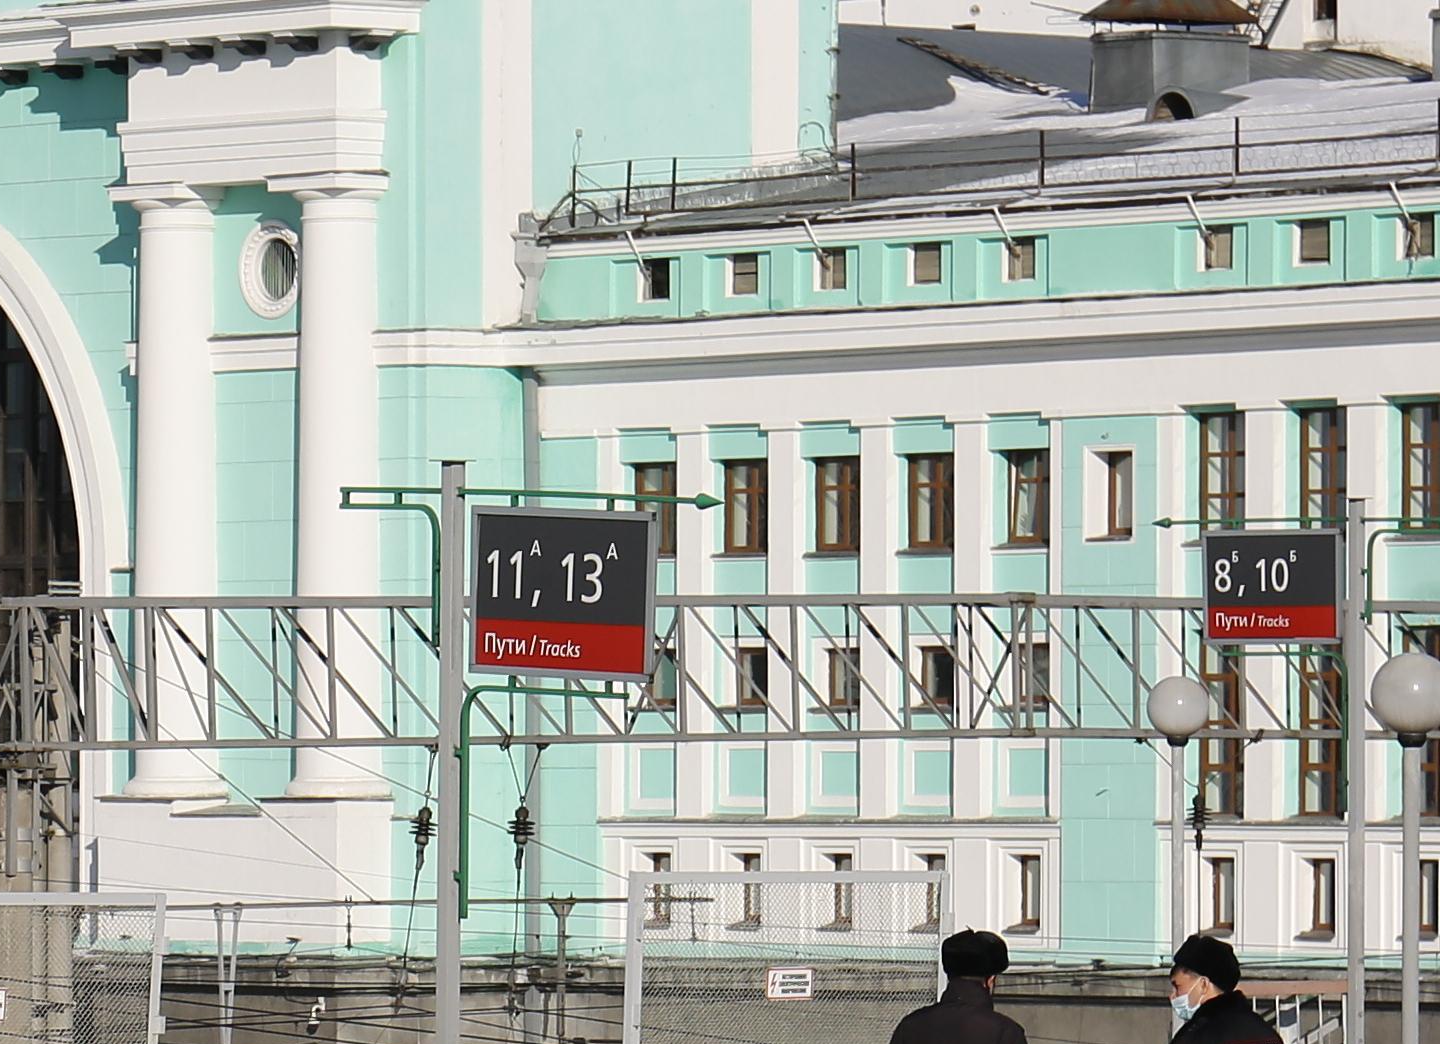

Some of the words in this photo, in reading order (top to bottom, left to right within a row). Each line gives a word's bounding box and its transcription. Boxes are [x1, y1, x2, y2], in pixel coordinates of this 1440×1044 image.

[1215, 612, 1248, 631] Пути
[1257, 614, 1290, 628] Tracks
[484, 632, 526, 659] Пути
[539, 639, 581, 658] Tracks
